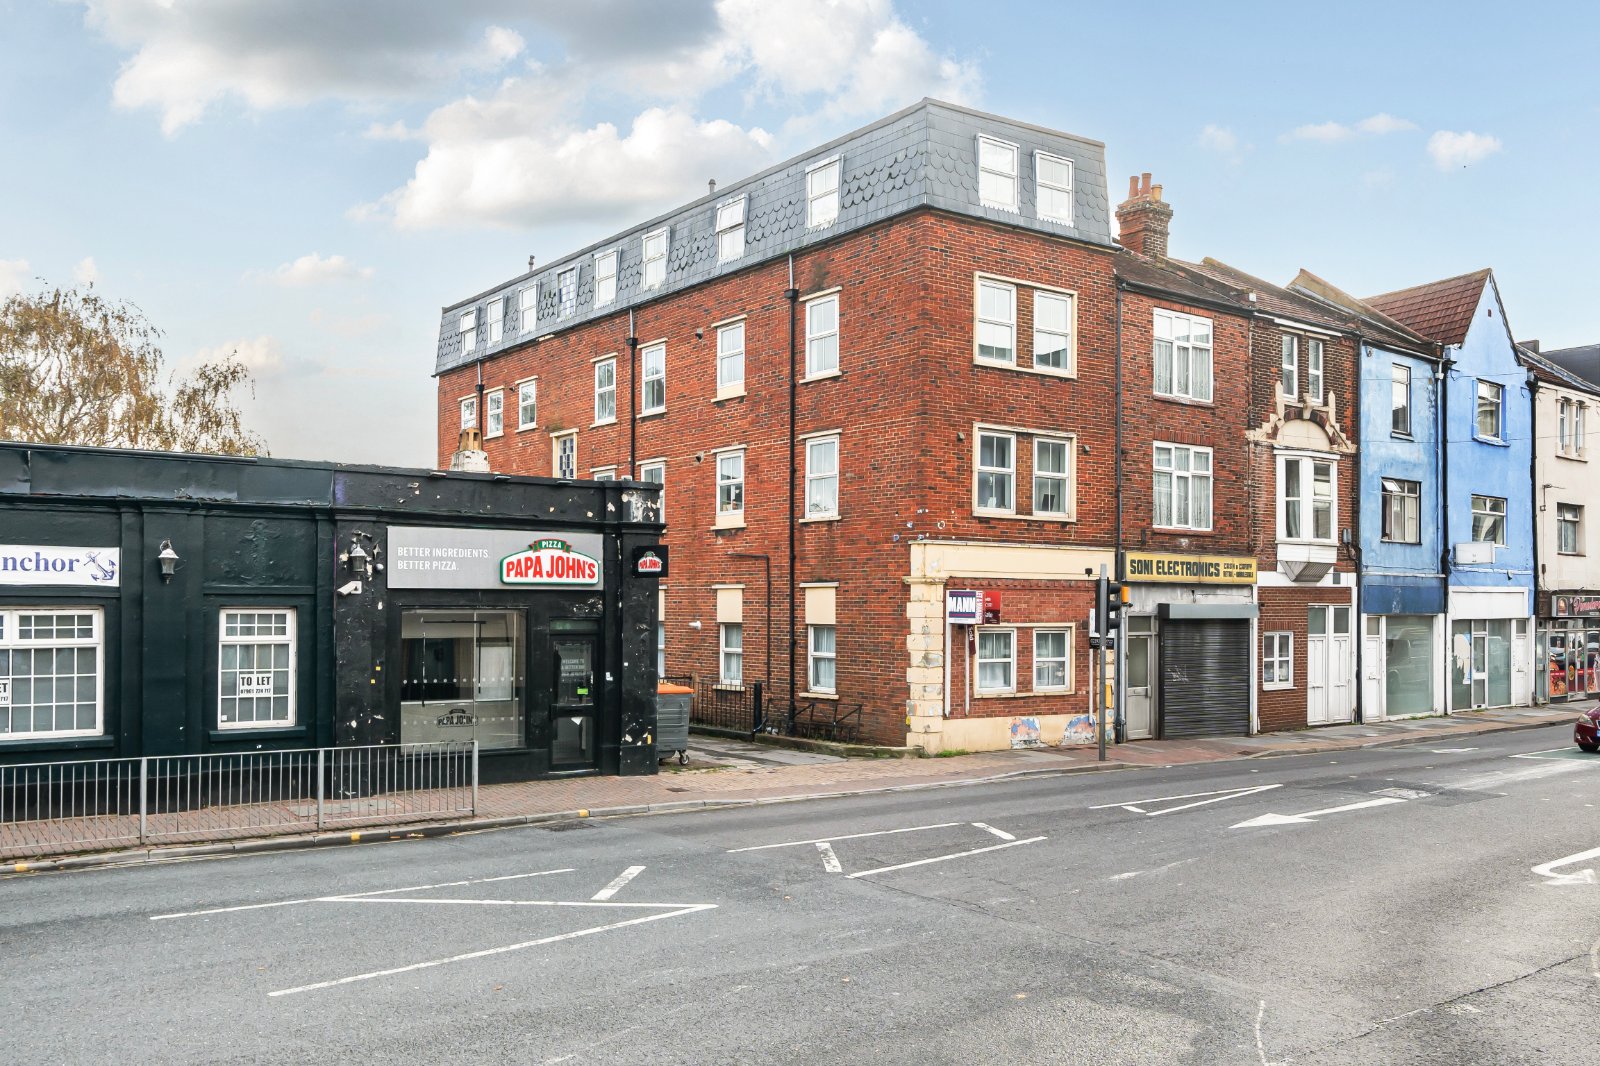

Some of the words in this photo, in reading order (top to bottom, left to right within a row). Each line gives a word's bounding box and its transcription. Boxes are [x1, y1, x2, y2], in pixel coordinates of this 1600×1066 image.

[541, 541, 562, 549] PIZZA
[397, 547, 430, 557] BETTER
[2, 552, 80, 572] nchor
[397, 561, 430, 570] BETTER
[433, 562, 460, 571] PIZZA.
[506, 556, 543, 578] PAPA
[546, 555, 595, 579] JOHN'S
[1130, 559, 1154, 575] SONI
[1156, 560, 1220, 577] ELECTRONICS
[949, 596, 976, 612] MANN
[241, 677, 252, 686] TO
[257, 677, 271, 685] LET
